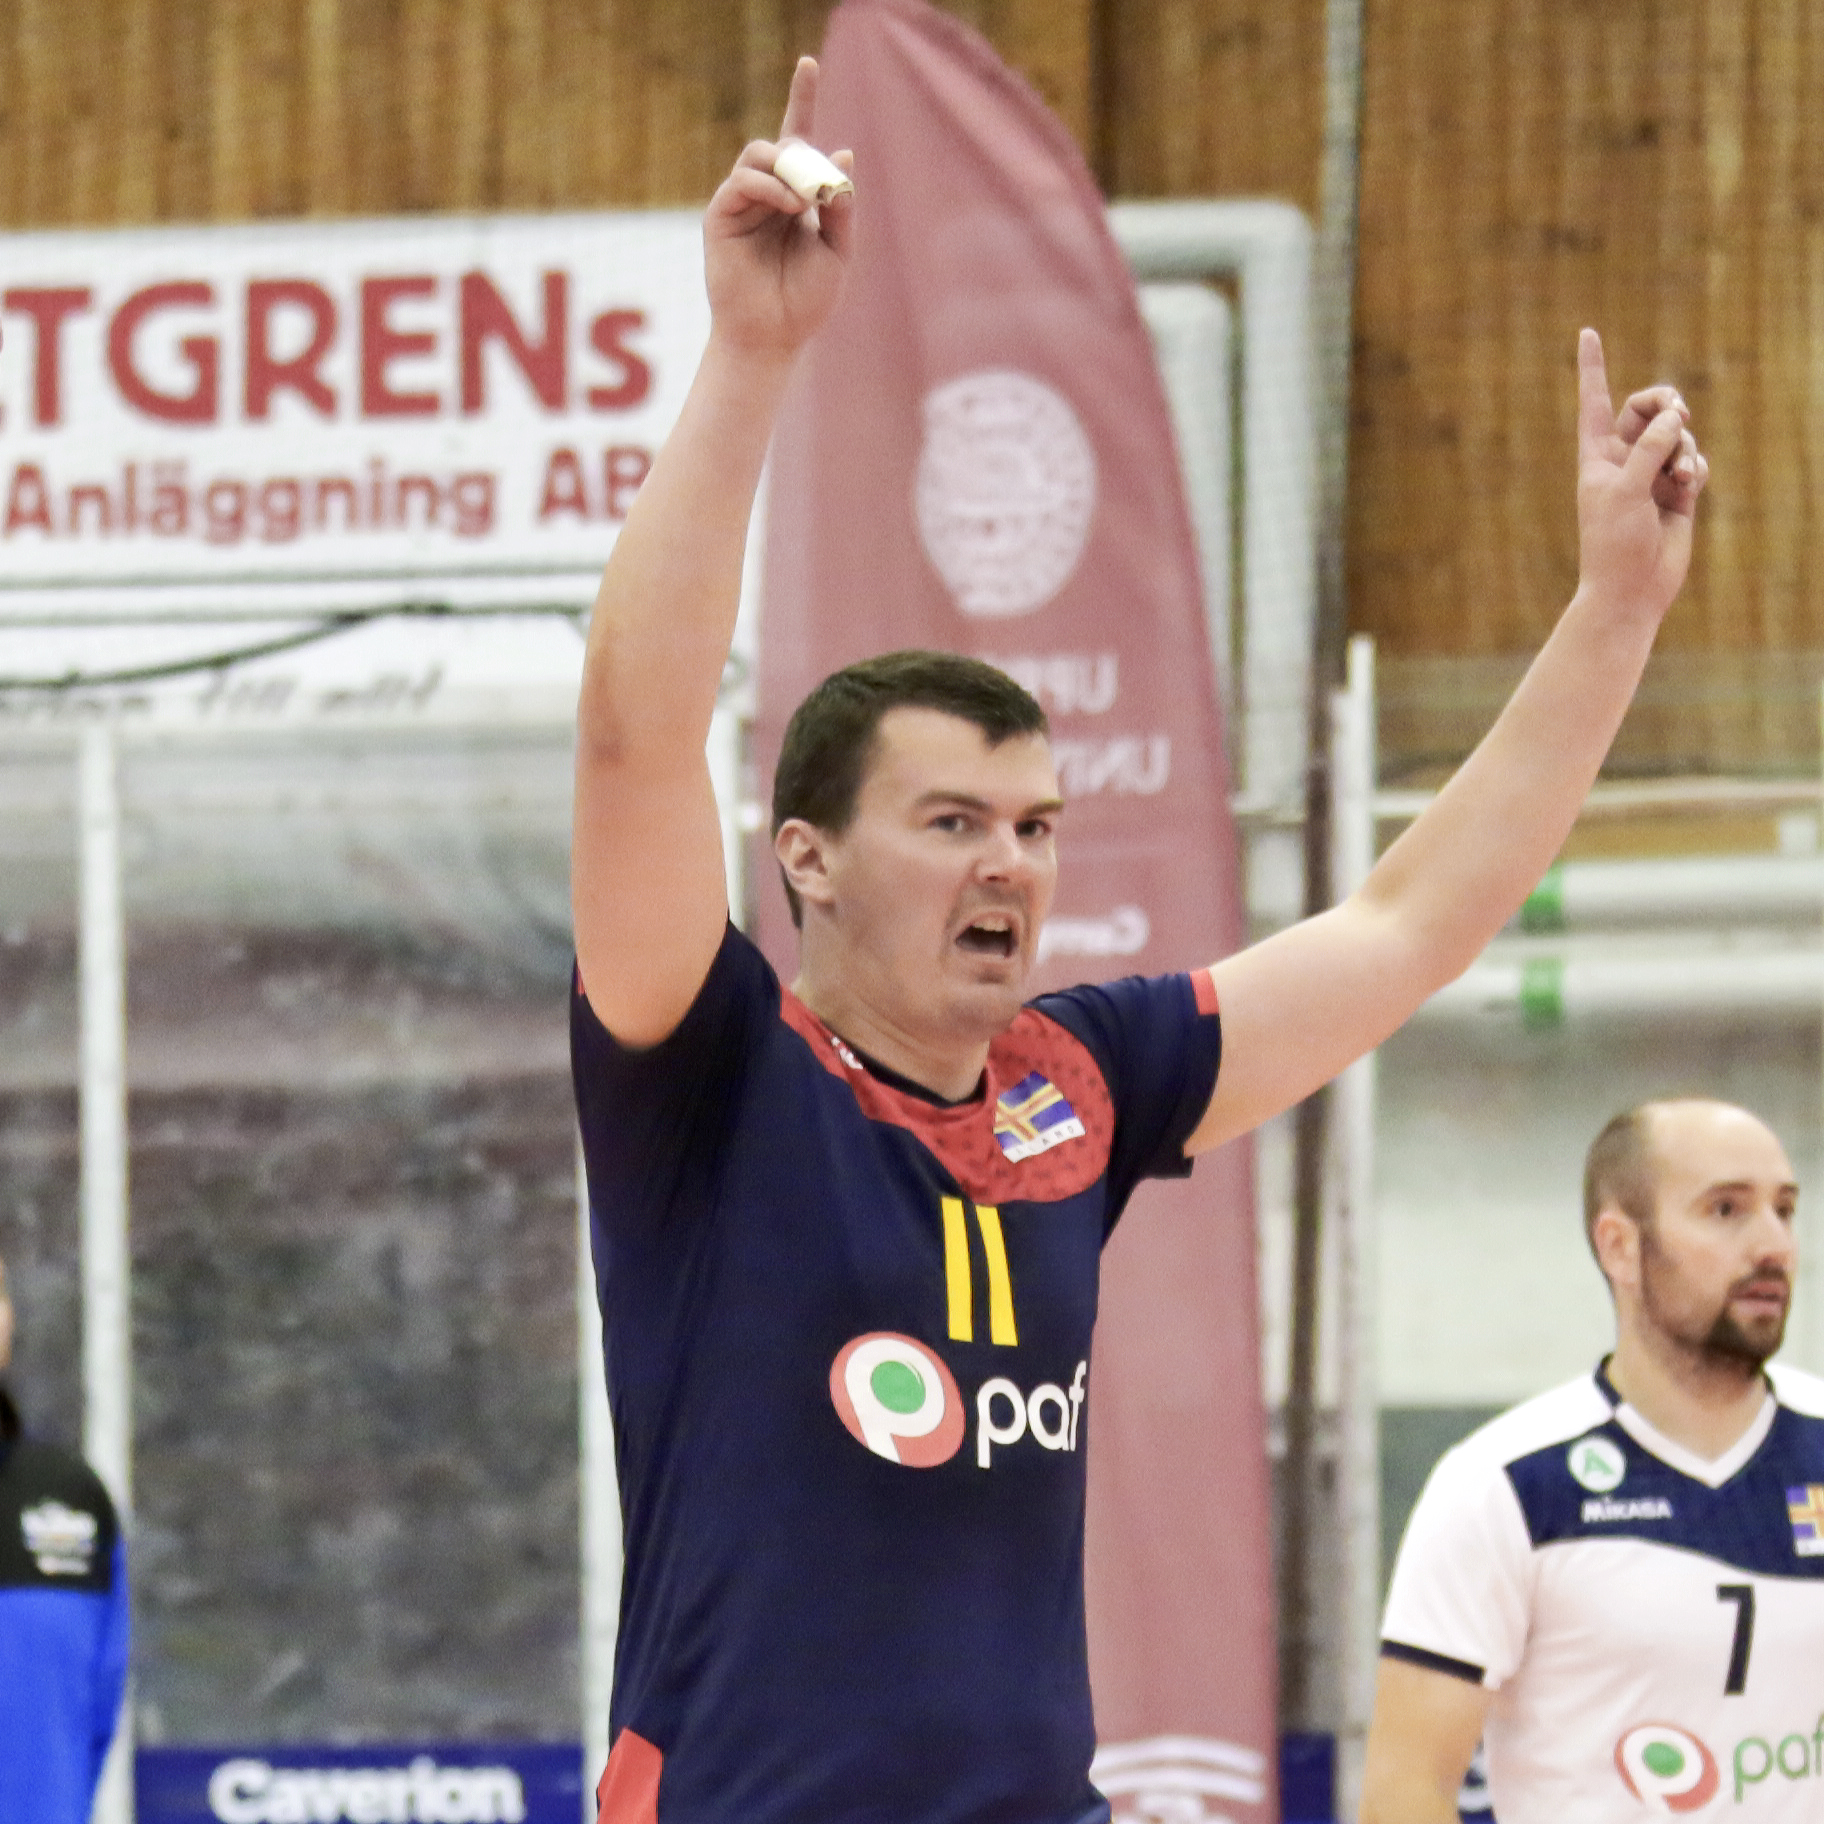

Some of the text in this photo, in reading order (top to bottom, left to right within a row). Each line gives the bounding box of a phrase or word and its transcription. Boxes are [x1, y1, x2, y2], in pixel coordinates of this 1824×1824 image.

[4, 456, 497, 543] Anläggning
[941, 1196, 1018, 1347] 11
[976, 1360, 1087, 1469] paf
[1716, 1584, 1756, 1695] 7
